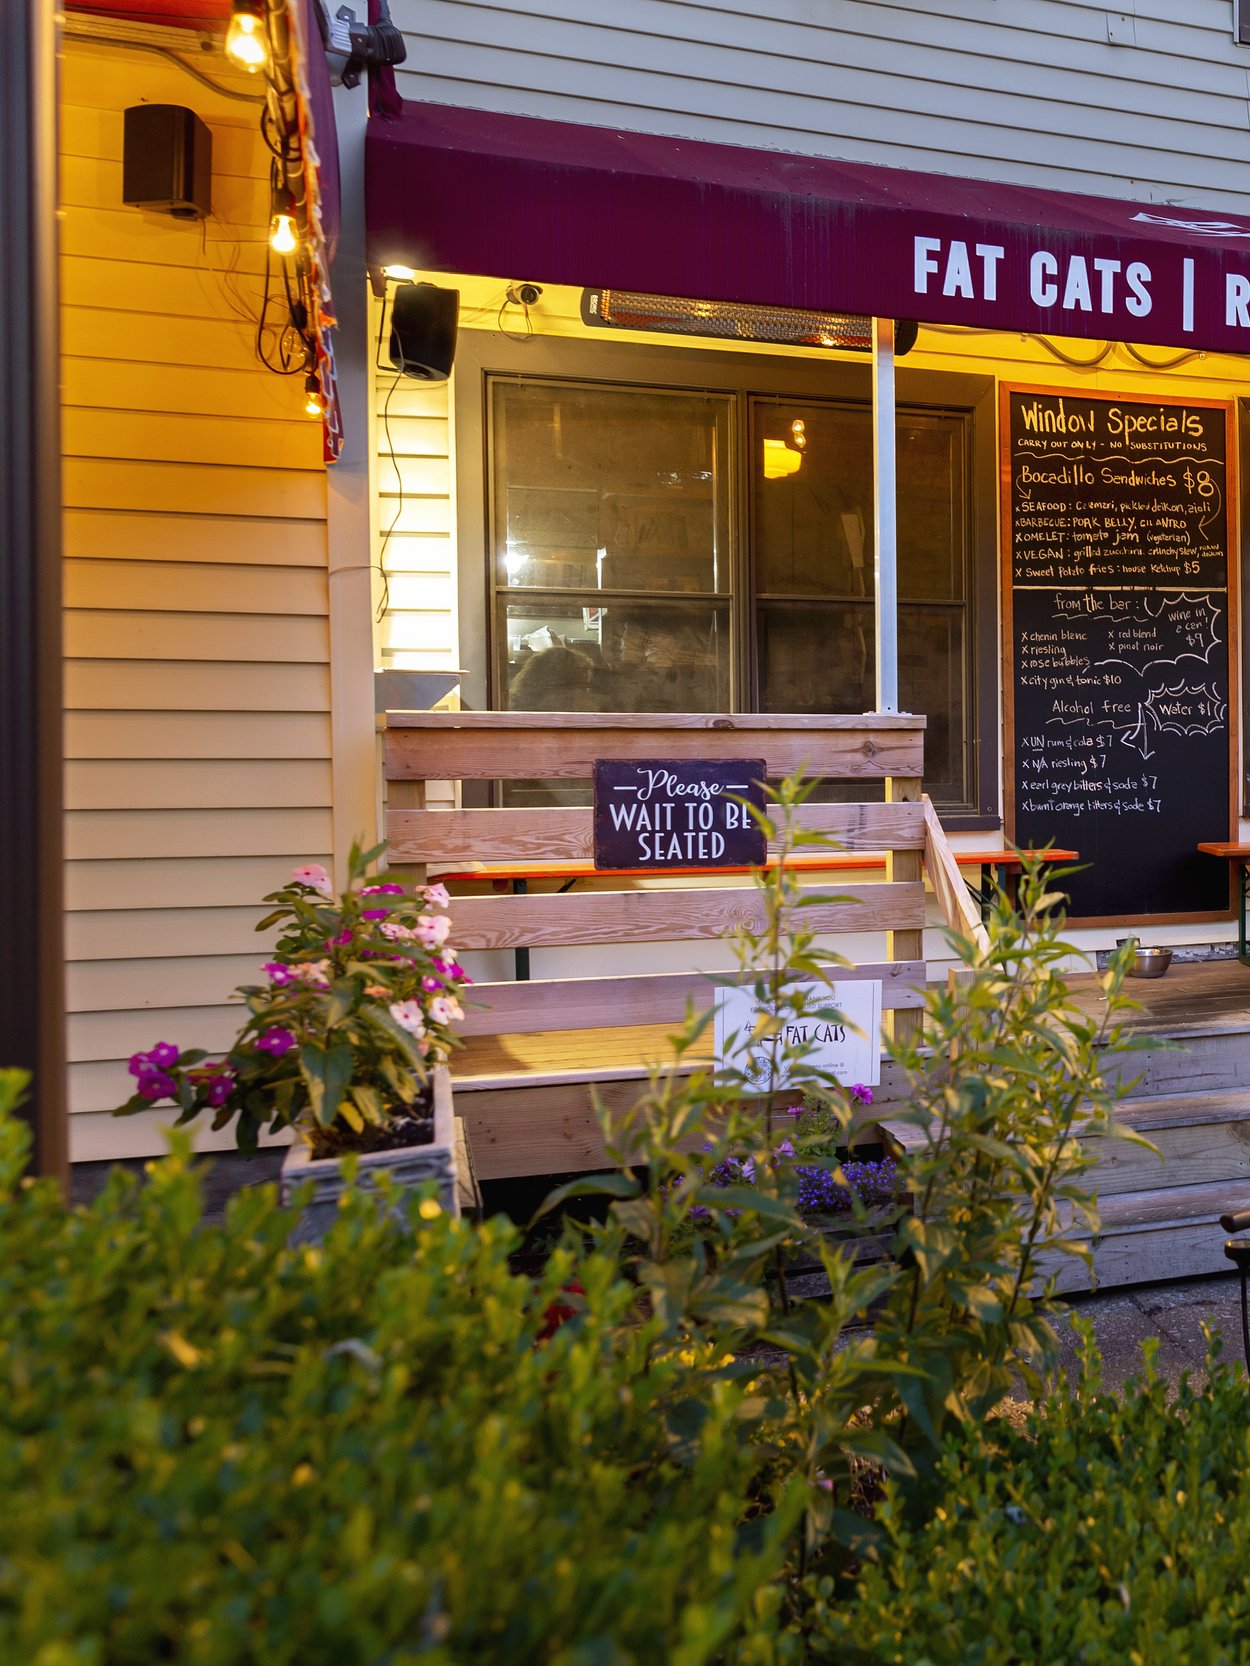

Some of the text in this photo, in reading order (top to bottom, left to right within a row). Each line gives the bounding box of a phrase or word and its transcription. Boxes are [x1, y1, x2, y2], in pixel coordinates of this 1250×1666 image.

[914, 236, 1004, 300] FAT
[1030, 251, 1152, 317] CATS
[1021, 398, 1204, 445] Window Specials
[1018, 439, 1047, 450] CARRY
[1071, 441, 1096, 450] ONLY
[1130, 441, 1207, 452] SUBSTITUTIONS
[1022, 464, 1214, 497] Bocadillo Sandwiches $8
[1073, 516, 1100, 529] PORK
[1140, 517, 1186, 529] CILANTRO
[1072, 529, 1108, 542] tomato
[1112, 529, 1139, 545] jam
[1148, 547, 1178, 560] crunchy
[1026, 566, 1054, 577] Sweet
[1122, 565, 1146, 573] house
[1184, 561, 1200, 574] $5
[1054, 593, 1080, 610] from
[1083, 593, 1104, 612] the
[1168, 608, 1206, 621] wine in
[1030, 632, 1057, 641] chenin
[1061, 629, 1088, 640] blanc
[1119, 629, 1130, 638] red
[1133, 627, 1156, 638] blend
[1185, 632, 1204, 647] $9
[1031, 645, 1066, 659] riesling
[1118, 641, 1139, 654] pinot
[1144, 643, 1164, 651] noir
[1053, 655, 1090, 667] bubbles
[1029, 675, 1047, 690] city
[1050, 676, 1065, 689] gin
[1077, 675, 1101, 685] tonic
[1103, 674, 1121, 685] $10
[1052, 700, 1131, 714] Alcohol free
[1160, 701, 1210, 716] Water $1
[1030, 735, 1044, 748] UN
[1074, 736, 1094, 746] cola
[1032, 756, 1048, 772] N/A
[1052, 757, 1088, 775] riesling
[637, 768, 724, 800] Please
[1030, 779, 1049, 789] earl
[1052, 781, 1072, 794] grey
[1074, 779, 1102, 791] bitters
[1112, 777, 1138, 789] soda
[1142, 773, 1157, 789] $7
[1055, 803, 1084, 816] orange
[1122, 798, 1144, 811] soda
[1147, 798, 1161, 812] $7
[609, 803, 751, 831] WAIT TO BE
[638, 832, 725, 860] SEATED
[786, 1024, 845, 1044] FAT CATS
